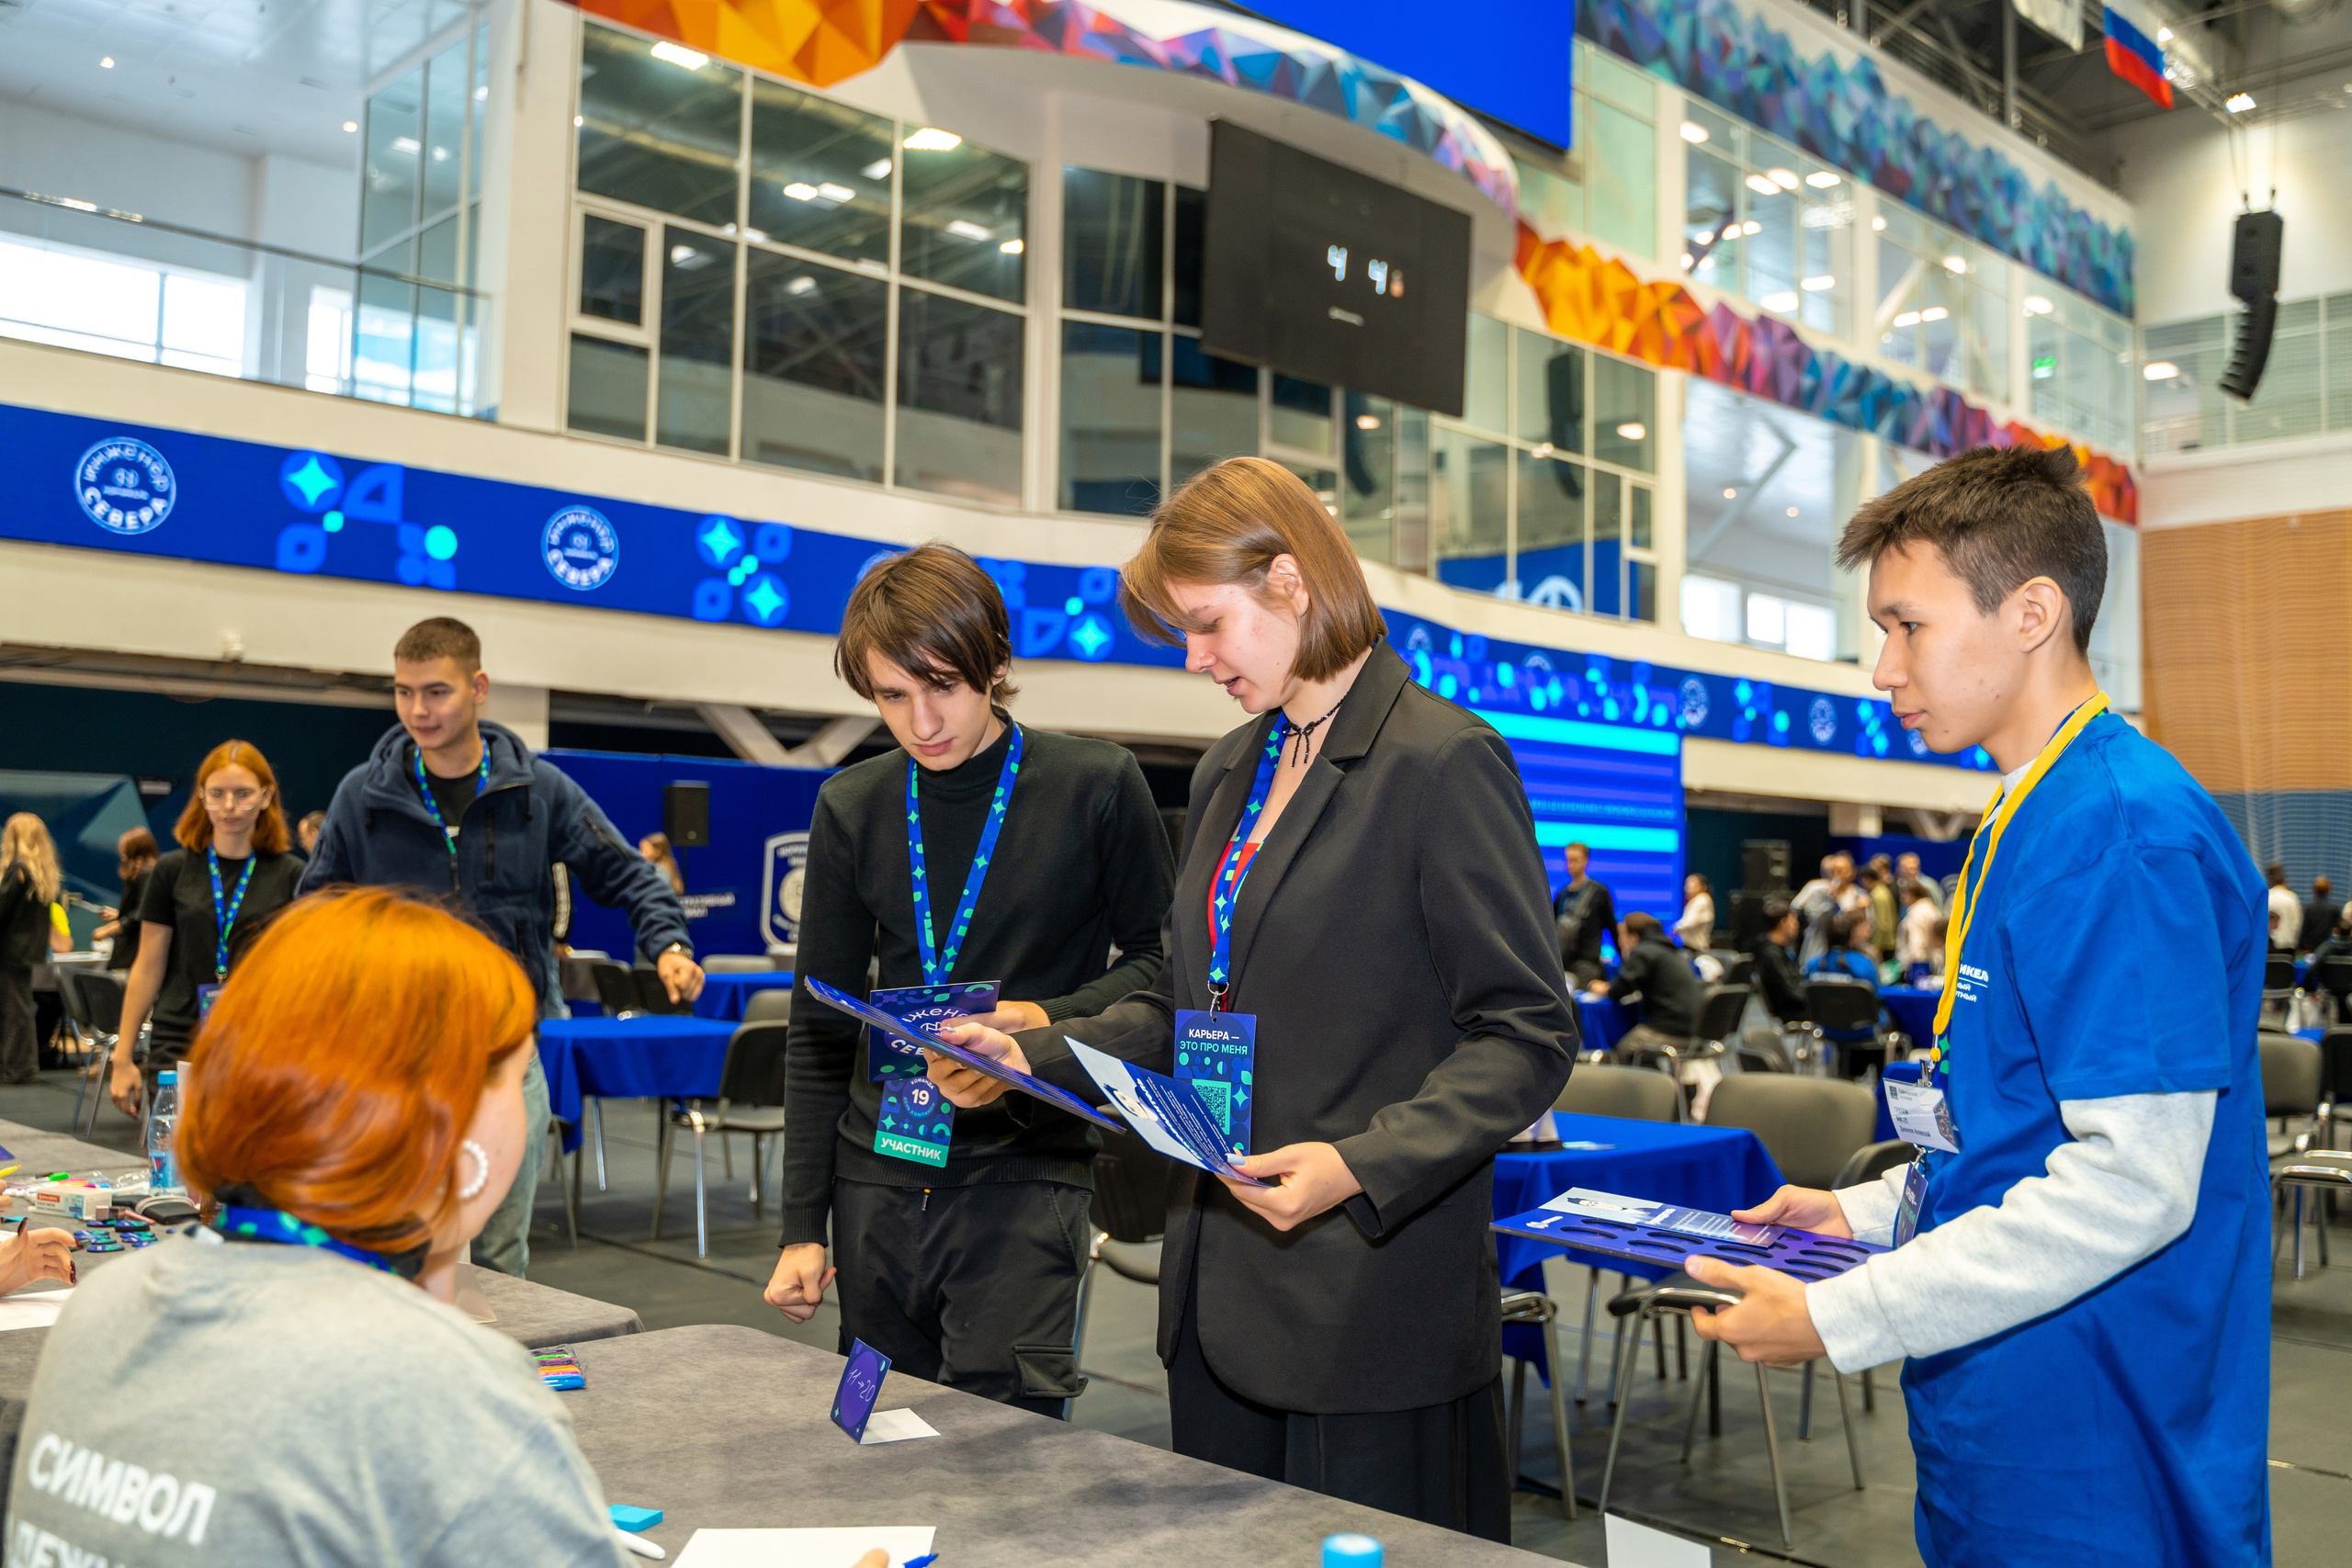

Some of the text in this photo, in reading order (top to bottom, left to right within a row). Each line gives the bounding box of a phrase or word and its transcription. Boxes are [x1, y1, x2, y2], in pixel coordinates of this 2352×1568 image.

[1188, 1028, 1229, 1041] КАРЬЕРА
[1180, 1040, 1248, 1055] ЭТО ПРО МЕНЯ
[910, 1077, 934, 1089] КОМАНДА
[911, 1089, 930, 1106] 19
[910, 1102, 935, 1117] КОМПАНИИ
[880, 1137, 942, 1161] УЧАСТНИК
[28, 1432, 217, 1547] СИМВОЛ
